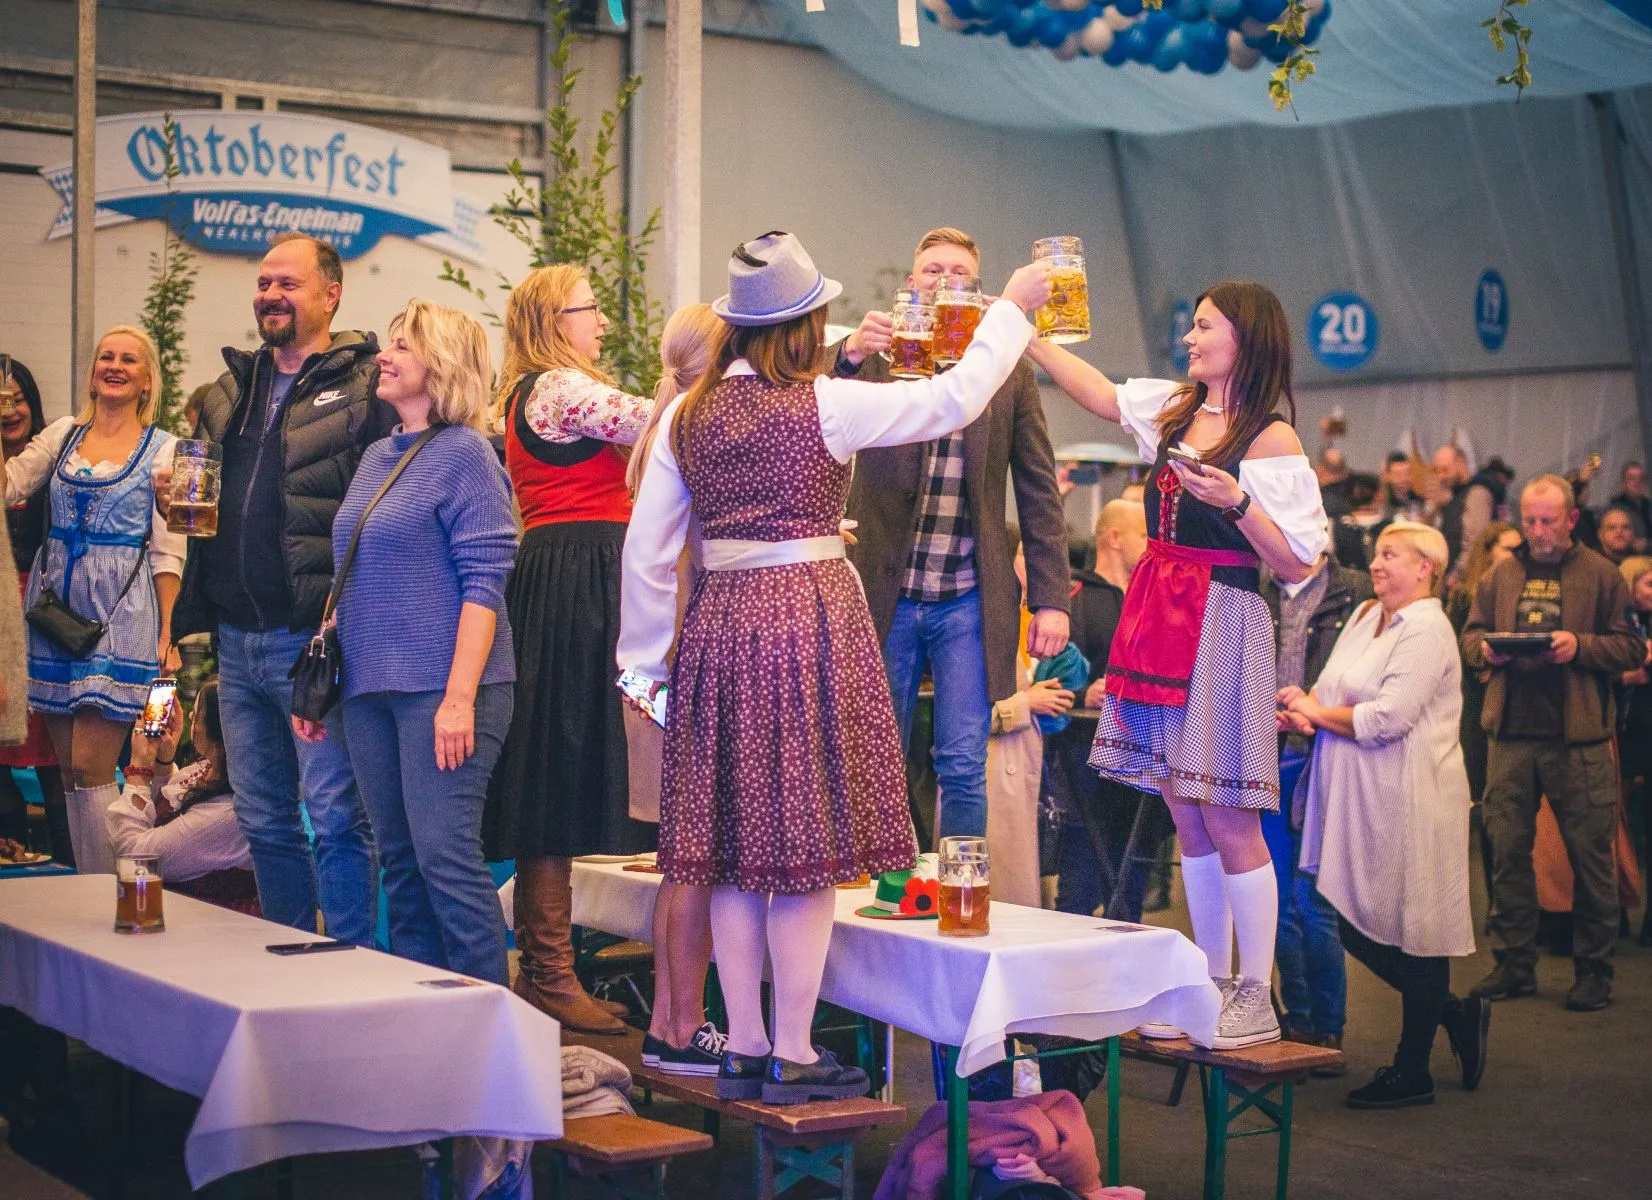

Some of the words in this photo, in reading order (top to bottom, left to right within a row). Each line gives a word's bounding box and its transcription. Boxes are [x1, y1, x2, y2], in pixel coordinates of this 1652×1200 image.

[126, 122, 405, 197] Oktoberfest
[1319, 303, 1366, 341] 20
[319, 390, 341, 400] NIKE
